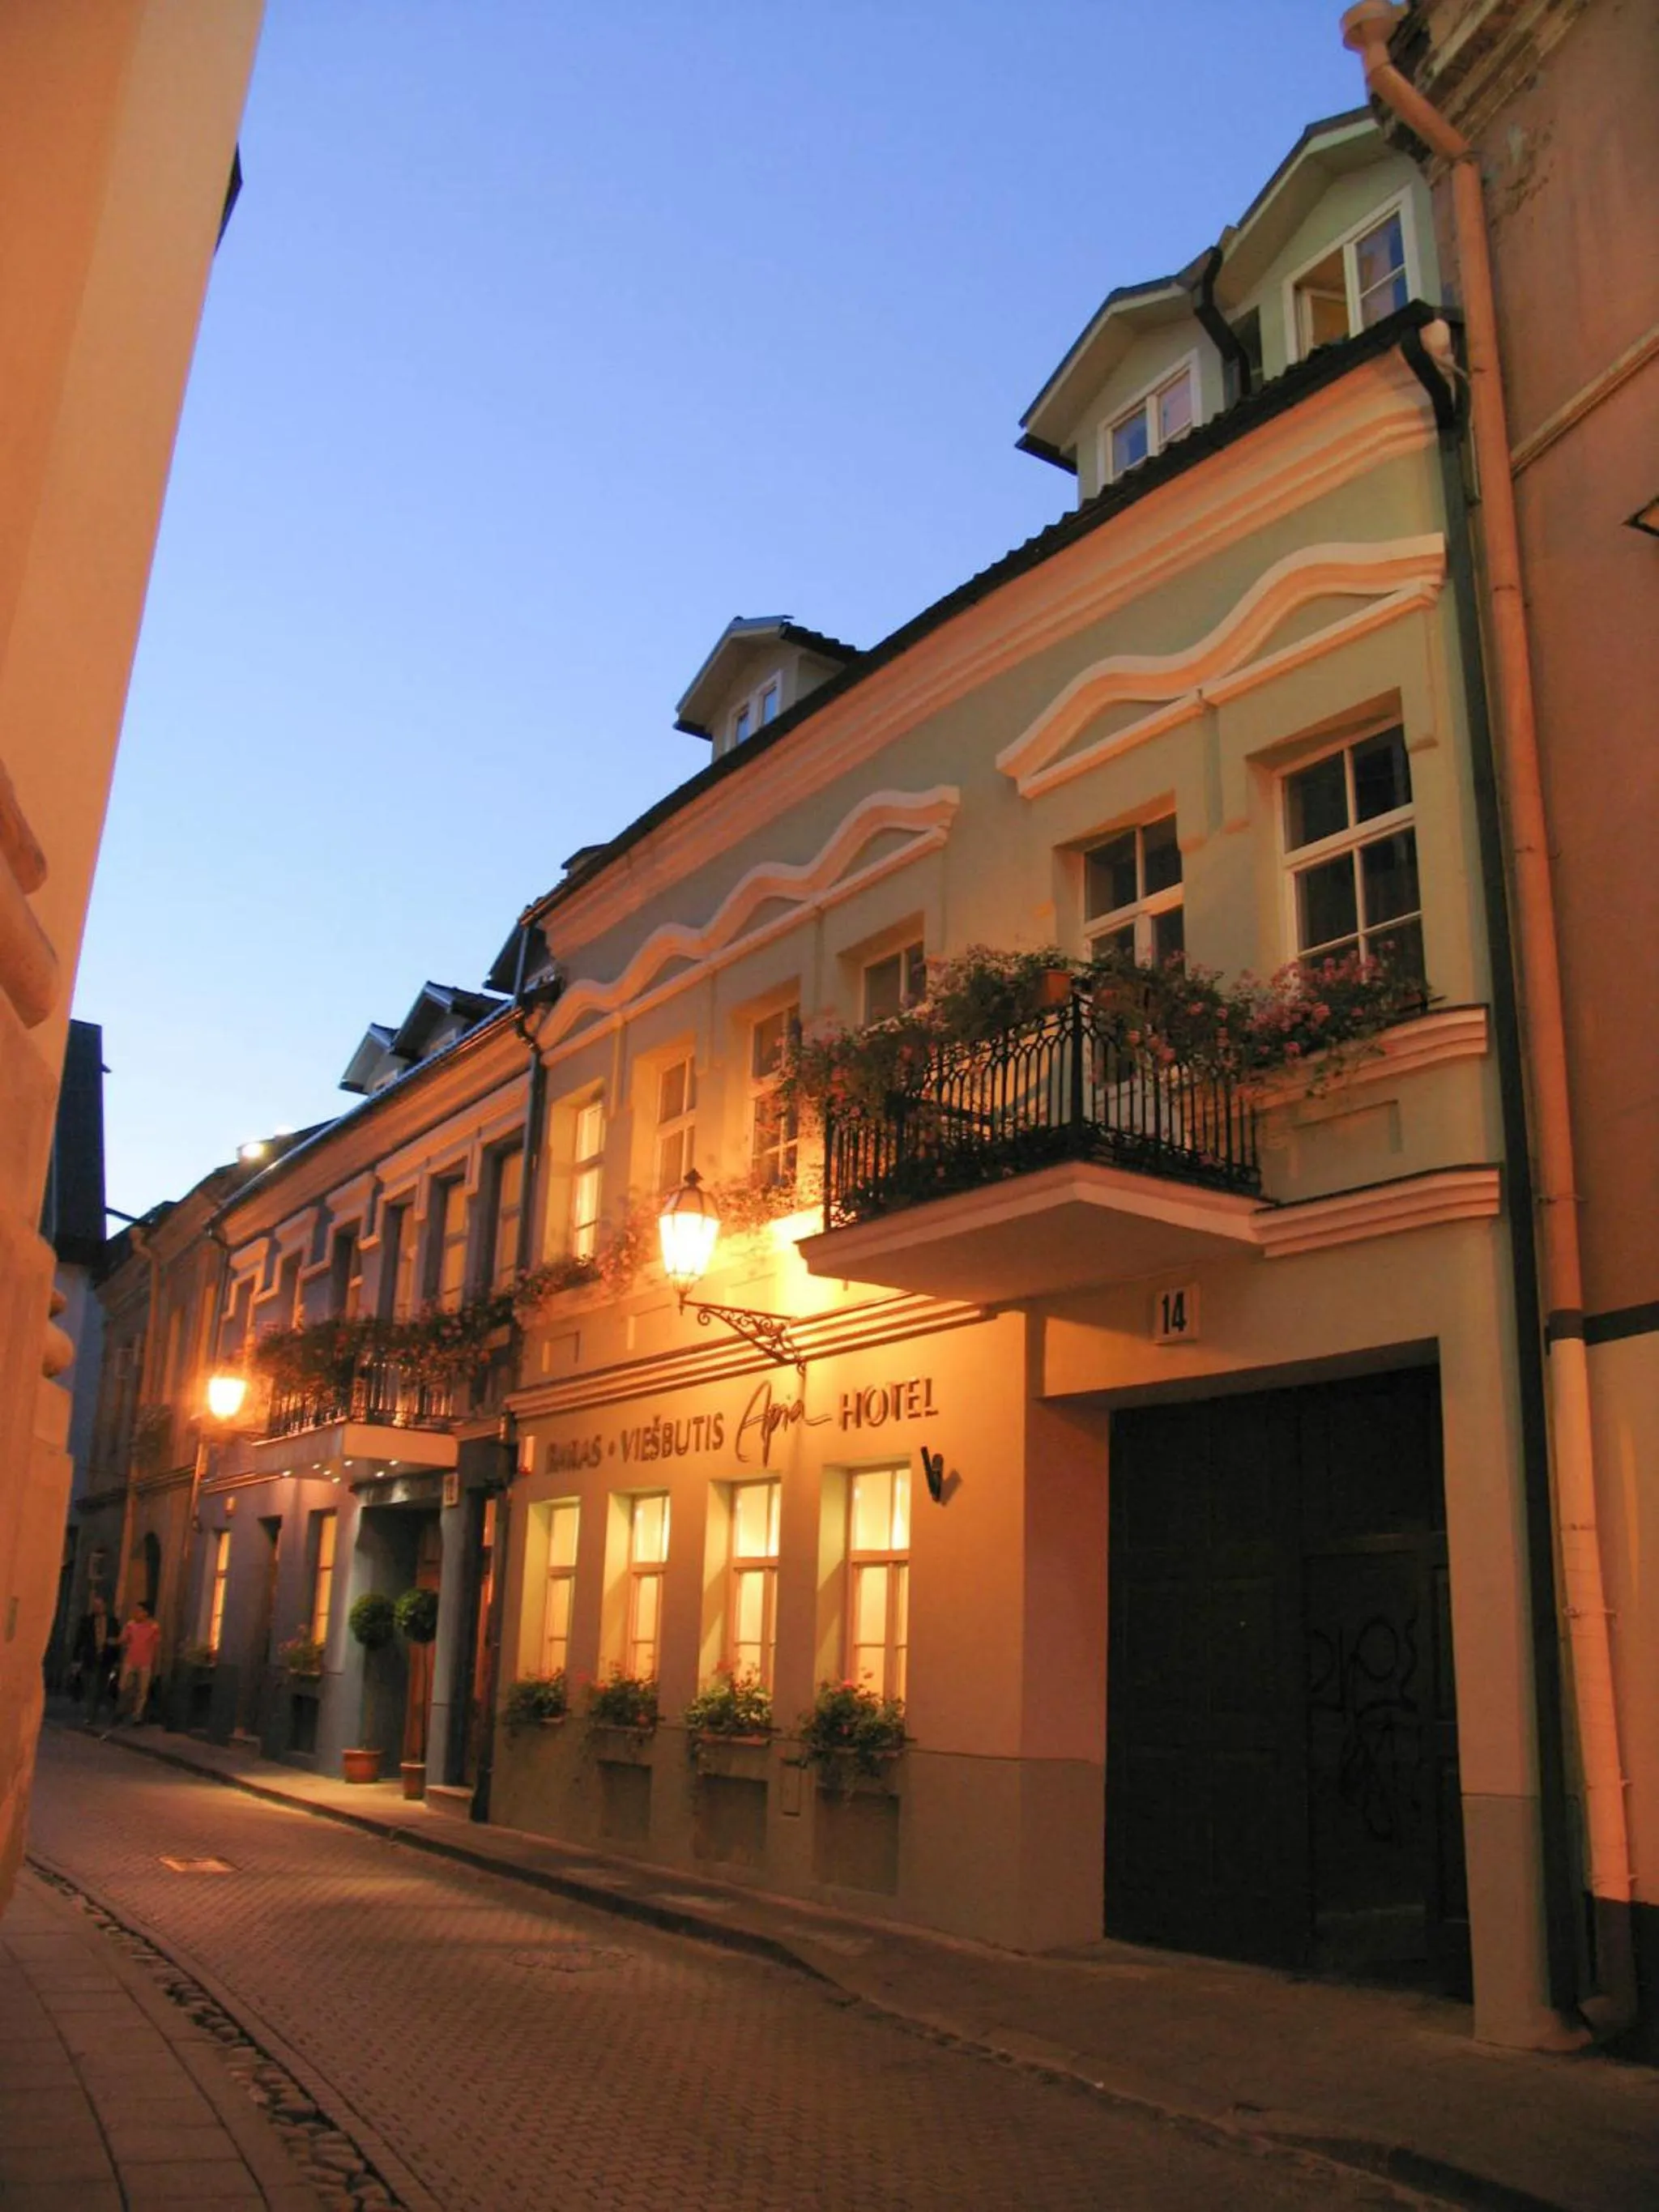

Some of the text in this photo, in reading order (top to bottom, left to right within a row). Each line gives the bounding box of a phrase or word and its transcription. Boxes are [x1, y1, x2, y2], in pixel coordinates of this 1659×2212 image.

[1162, 1291, 1188, 1336] 14
[620, 1413, 724, 1463] VIEŠBUTIS
[839, 1377, 940, 1432] HOTEL
